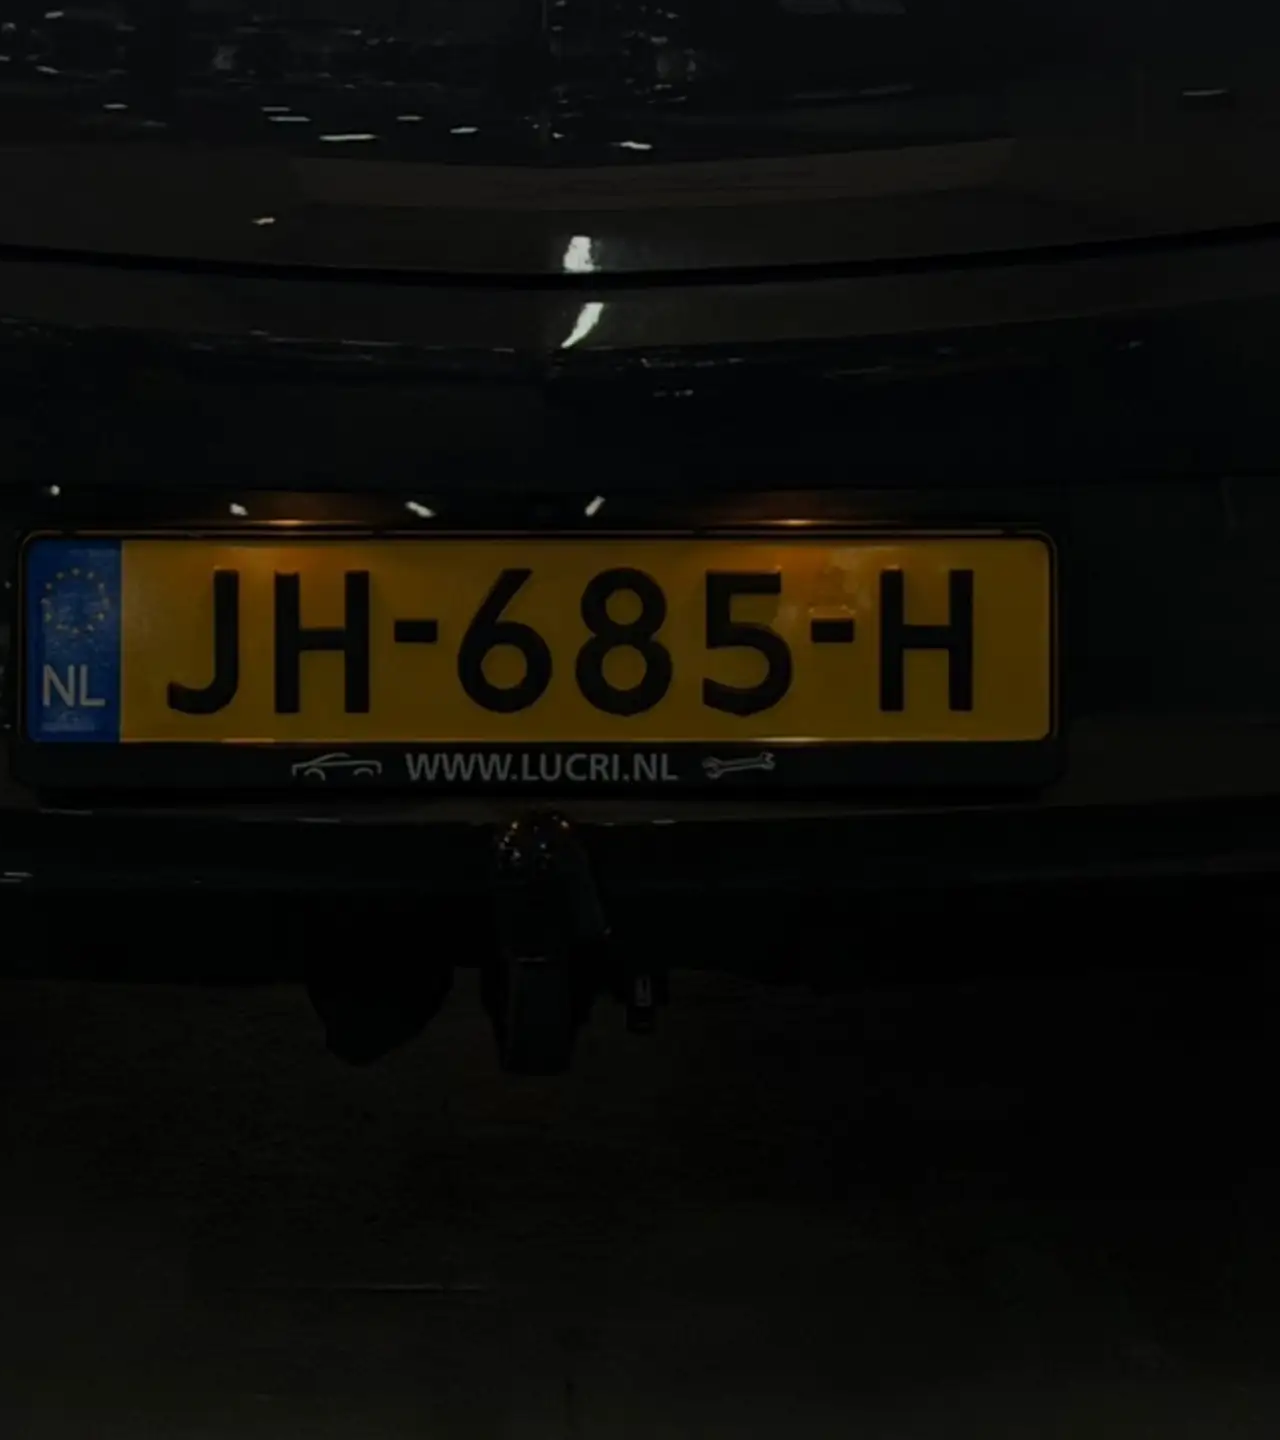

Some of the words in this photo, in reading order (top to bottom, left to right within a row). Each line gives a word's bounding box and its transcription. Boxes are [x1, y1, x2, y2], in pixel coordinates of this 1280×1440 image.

[167, 567, 974, 716] JH-685-H
[41, 664, 106, 708] NL
[404, 751, 680, 783] WWW.LUCRI.NL
